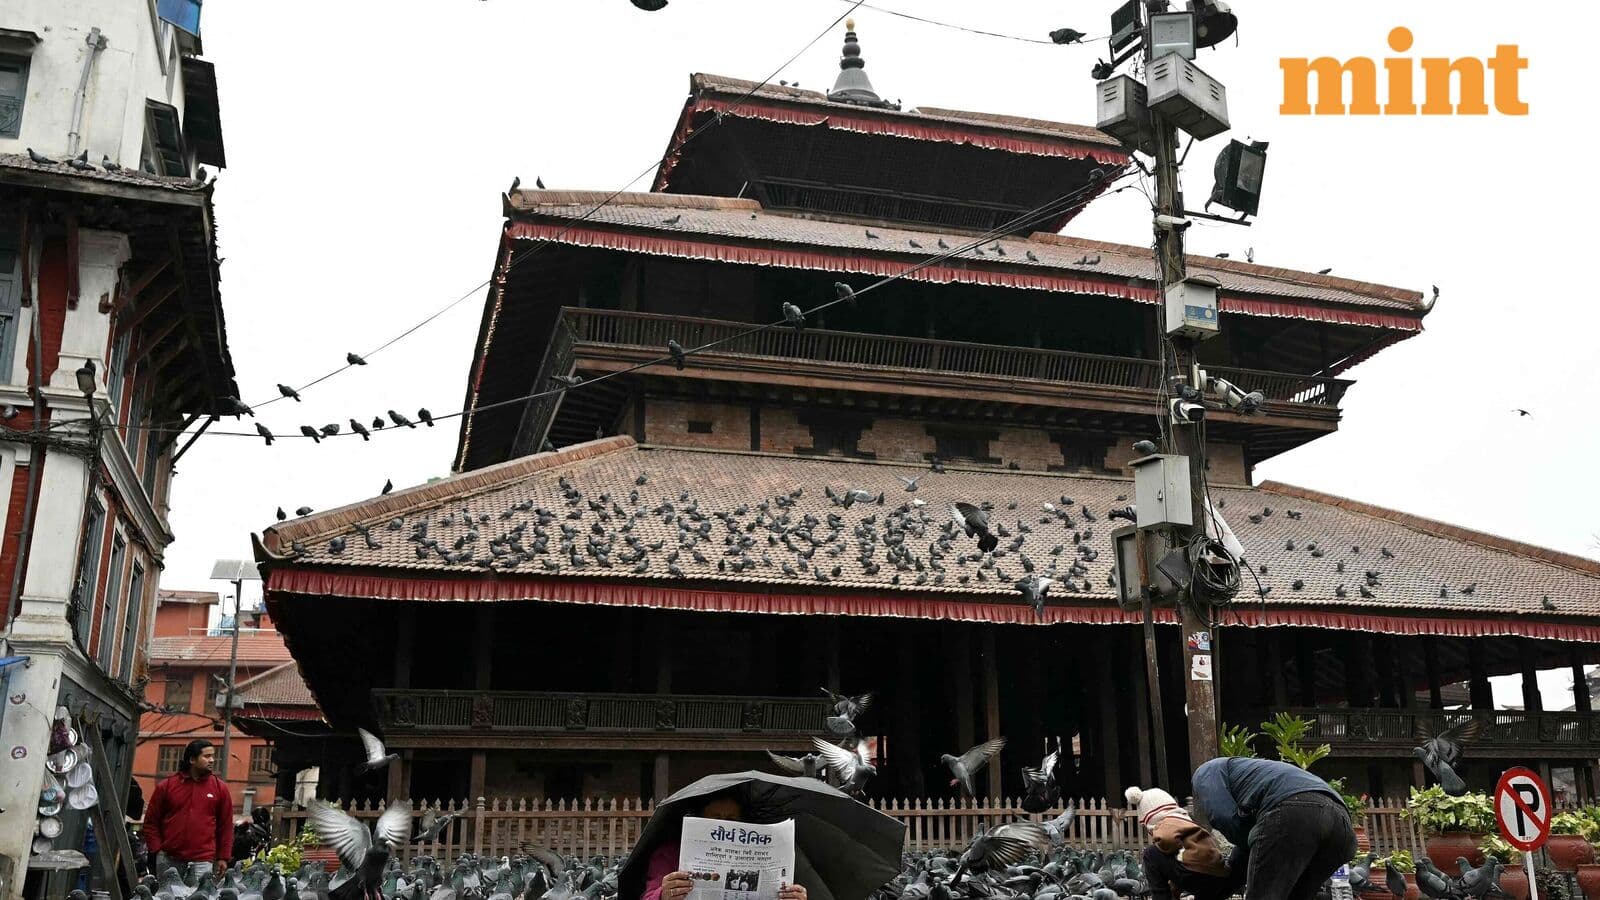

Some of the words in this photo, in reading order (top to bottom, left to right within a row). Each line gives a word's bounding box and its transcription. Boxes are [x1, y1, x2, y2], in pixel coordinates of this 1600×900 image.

[1512, 784, 1539, 836] P
[711, 825, 736, 842] सौर्य
[739, 828, 772, 845] दैनिक
